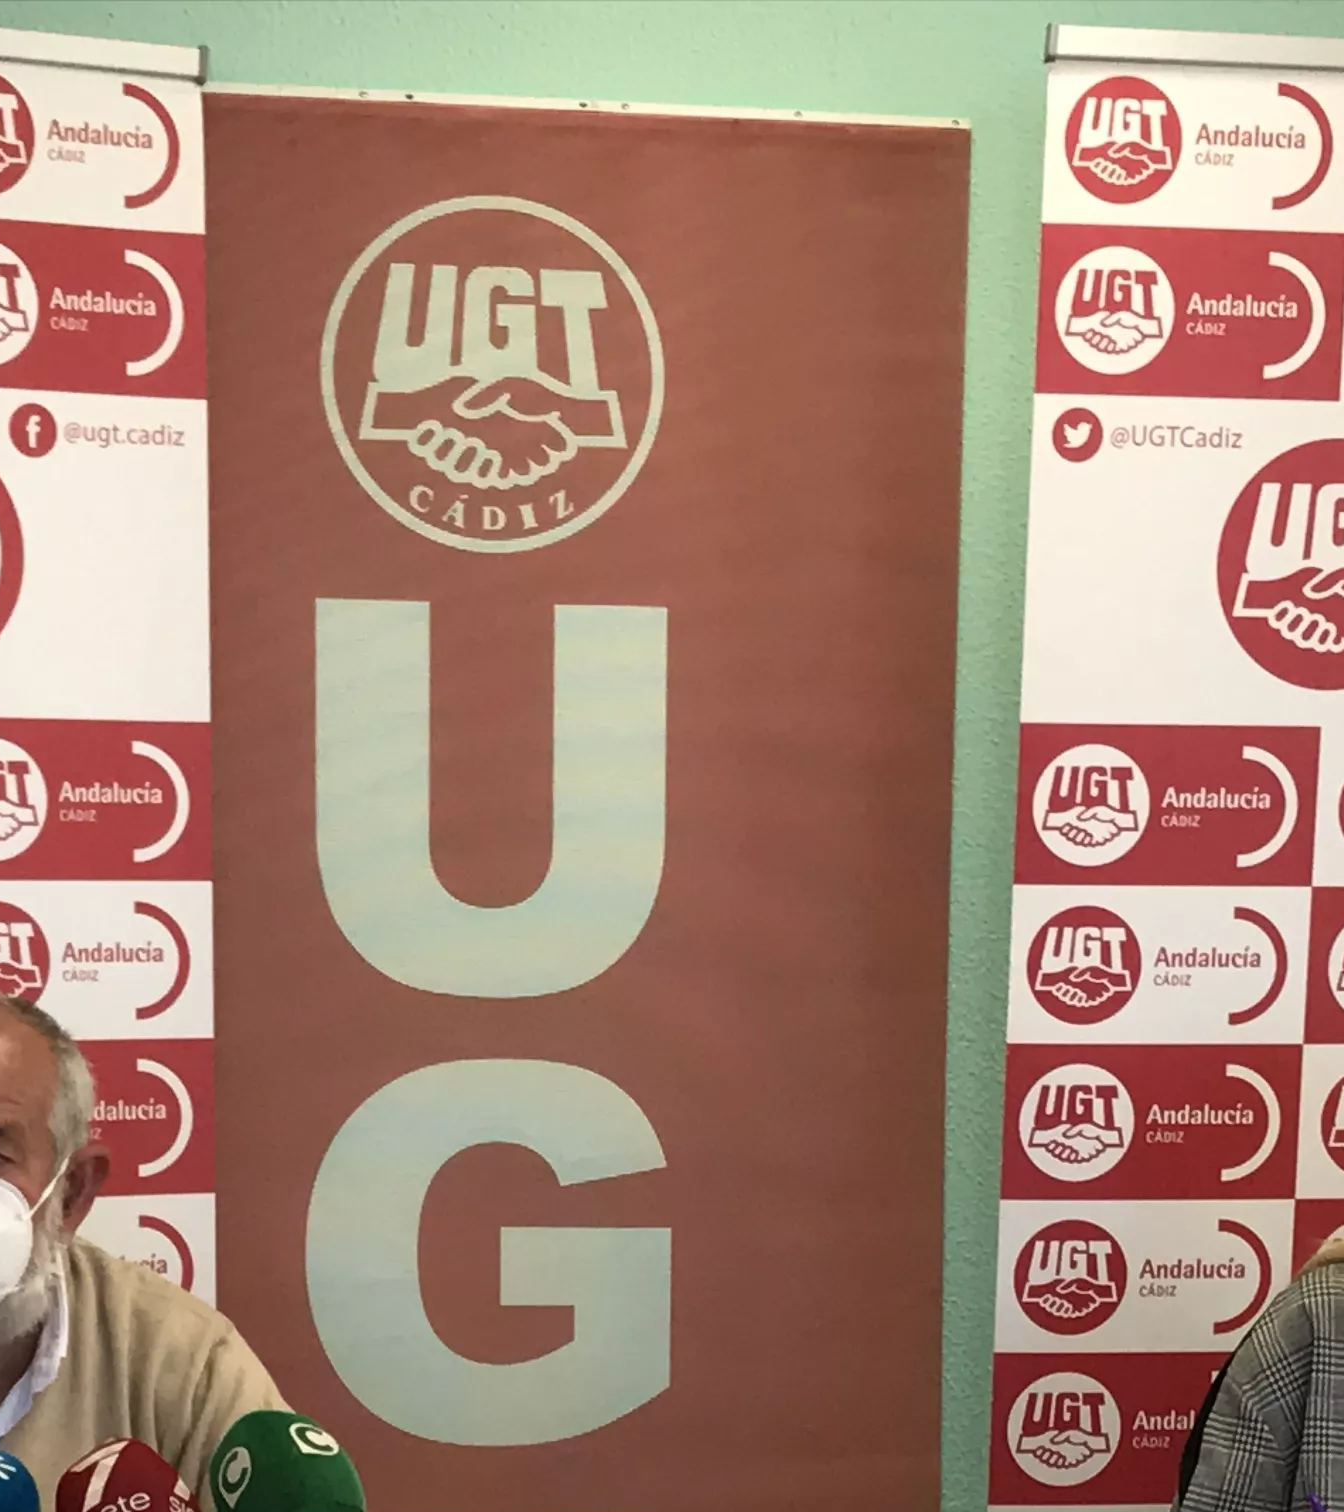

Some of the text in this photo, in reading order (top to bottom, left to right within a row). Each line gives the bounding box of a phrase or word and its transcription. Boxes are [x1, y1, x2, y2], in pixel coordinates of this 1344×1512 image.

[1082, 96, 1166, 148] UGT
[1196, 124, 1305, 149] Andalucía
[1072, 269, 1158, 320] UGT
[1187, 293, 1297, 318] Andalucía
[373, 263, 608, 400] UGT
[64, 422, 184, 448] @ugt.cadiz
[1111, 425, 1242, 449] @UGTCadiz
[409, 485, 574, 530] CÁDIZ
[59, 781, 162, 804] Andalucía
[1053, 767, 1134, 818] UGT
[1162, 787, 1270, 809] Andalucía
[62, 942, 163, 962] Andalucía
[1044, 927, 1126, 976] UGT
[1155, 947, 1260, 968] Andalucía
[1036, 1086, 1118, 1134] UGT
[1147, 1104, 1253, 1124] Andalucía
[1030, 1241, 1110, 1286] UGT
[1140, 1258, 1245, 1279] Andalucía
[1022, 1393, 1105, 1436] UGT
